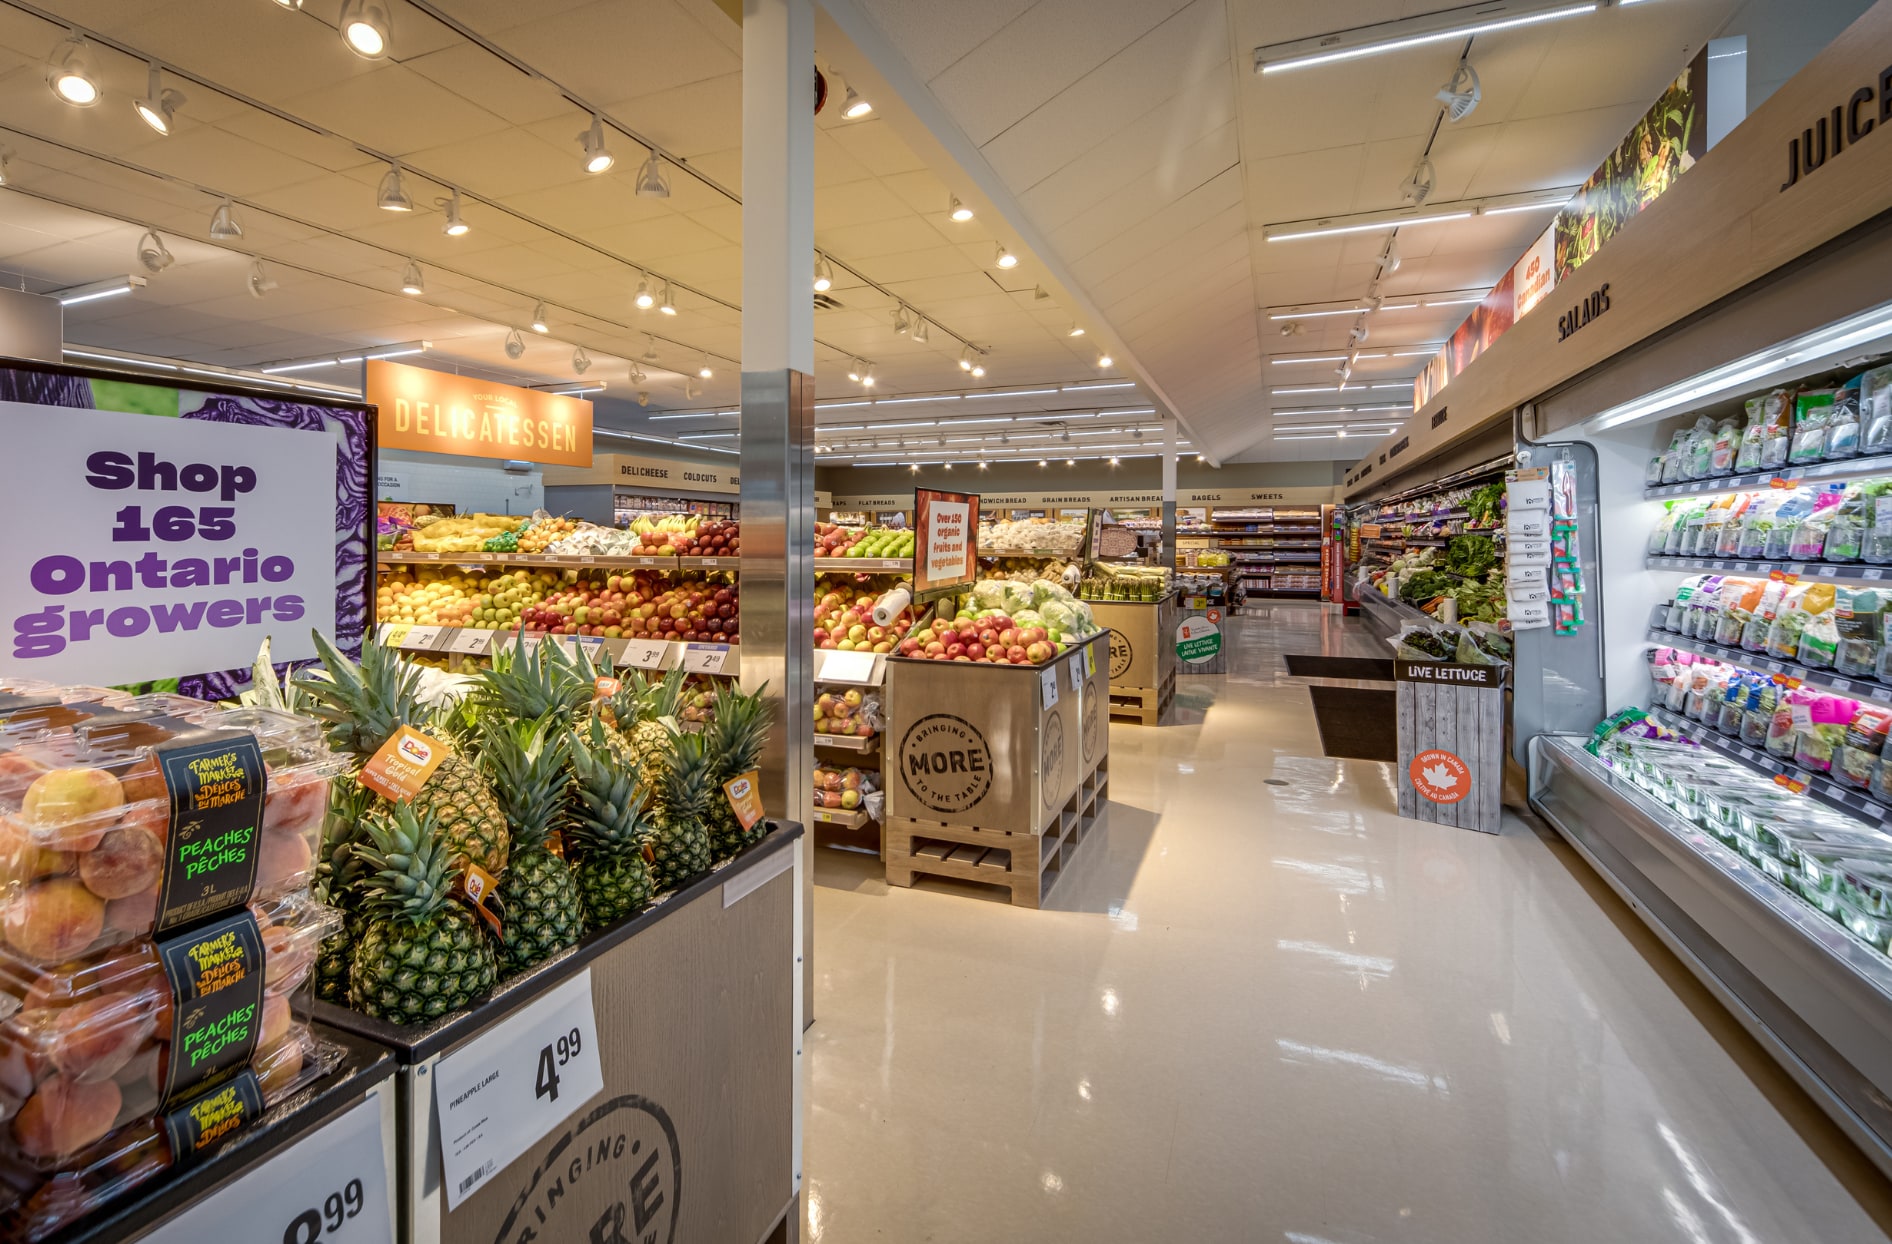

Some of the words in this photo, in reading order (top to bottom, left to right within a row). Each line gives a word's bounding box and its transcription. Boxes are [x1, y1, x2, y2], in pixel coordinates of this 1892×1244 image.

[1526, 256, 1540, 281] 450
[1558, 283, 1610, 343] SALADS
[395, 397, 576, 453] DELICATESSEN
[85, 451, 257, 500] Shop
[621, 465, 639, 476] DELI
[640, 467, 668, 479] CHEESE
[684, 472, 700, 482] COLD
[701, 474, 717, 483] CUTS
[730, 476, 740, 485] DEL
[112, 506, 236, 542] 165
[936, 512, 950, 524] Over
[937, 526, 960, 539] organic
[933, 541, 950, 553] fruits
[951, 541, 962, 552] and
[30, 547, 295, 595] Ontario
[931, 556, 963, 570] vegetables
[13, 594, 305, 659] growers
[1109, 645, 1127, 659] RE
[1435, 666, 1487, 682] LETTUCE
[917, 724, 966, 743] BRINGING
[189, 753, 237, 774] FARMER'S
[199, 766, 236, 785] MARKET
[385, 754, 422, 777] Tropical
[385, 765, 407, 782] Gold
[908, 748, 985, 776] MORE
[917, 779, 928, 793] TO
[931, 790, 951, 803] THE
[955, 774, 982, 802] TABLE
[179, 827, 253, 862] PEACHES
[186, 848, 246, 880] PÊCHES
[188, 931, 236, 962] FARMER'S
[184, 1003, 255, 1052] PEACHES
[191, 1026, 248, 1067] PÊCHES
[450, 1083, 481, 1111] PINEAPPLE
[481, 1070, 500, 1088] LARGE
[516, 1134, 626, 1244] RINGING
[590, 1148, 664, 1244] RE
